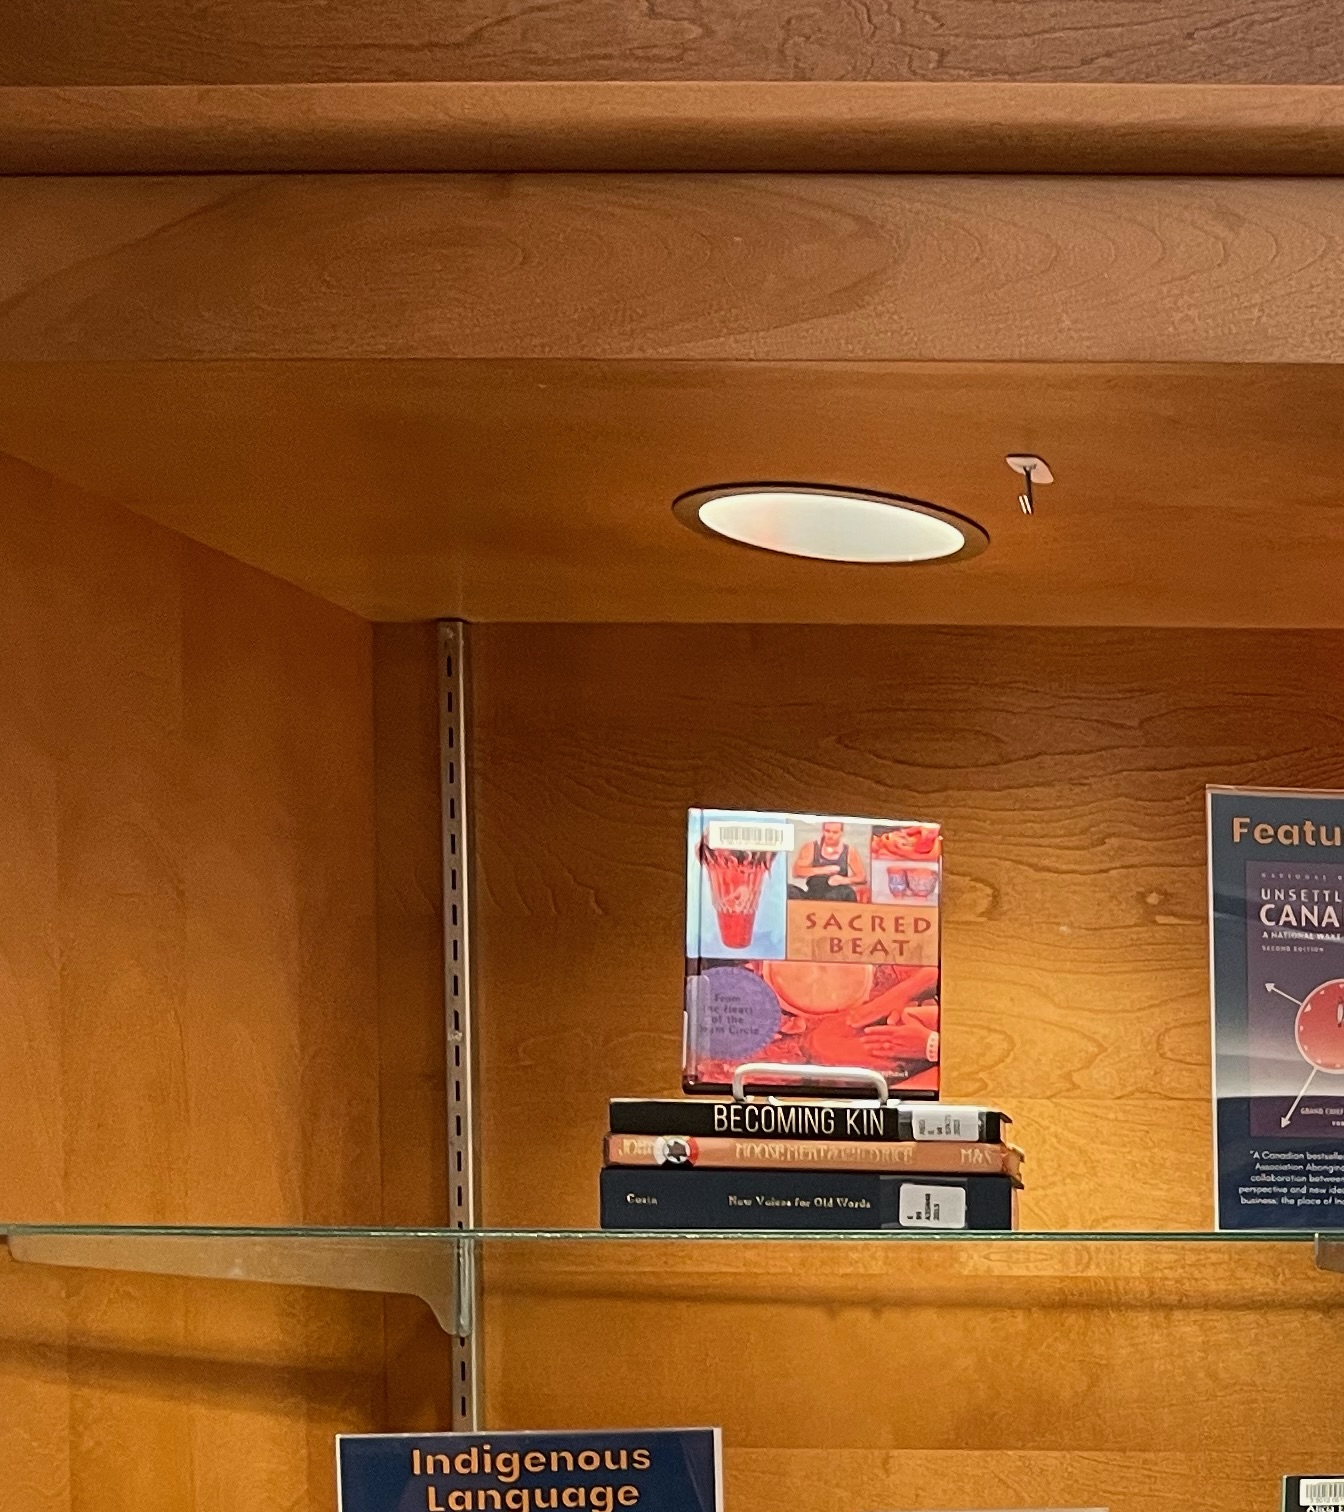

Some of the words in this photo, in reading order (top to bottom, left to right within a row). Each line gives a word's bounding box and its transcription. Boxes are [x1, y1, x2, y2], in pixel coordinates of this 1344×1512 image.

[806, 911, 932, 935] SACRED
[829, 937, 910, 957] BEAT
[713, 1104, 835, 1135] BECOMING
[846, 1109, 885, 1137] KIN
[412, 1444, 652, 1484] Indigenous
